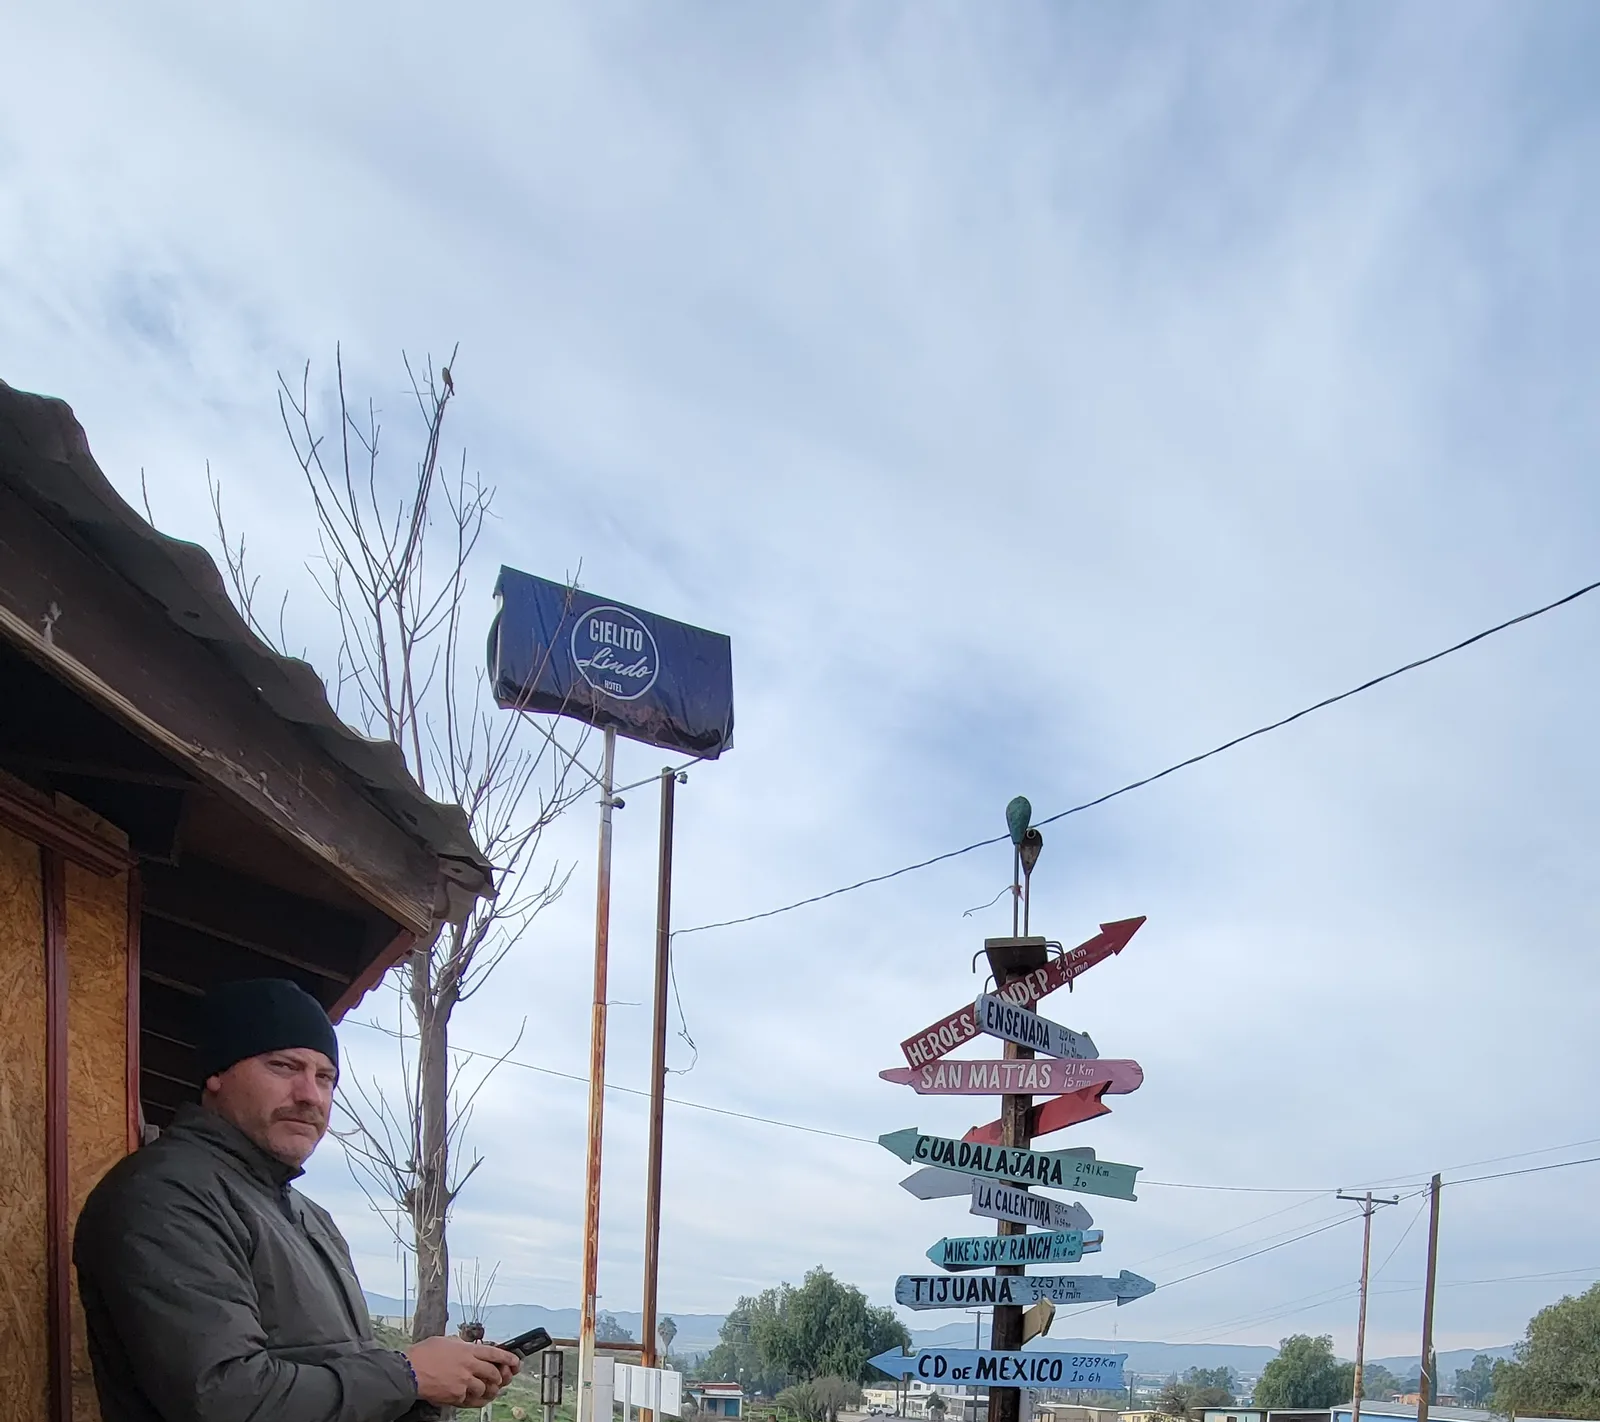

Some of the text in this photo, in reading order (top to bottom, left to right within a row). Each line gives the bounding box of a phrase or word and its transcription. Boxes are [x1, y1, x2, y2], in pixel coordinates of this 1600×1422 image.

[589, 618, 643, 652] CIELITO
[576, 647, 653, 678] Lindo
[604, 679, 623, 694] HOTEL
[1070, 948, 1087, 961] Km
[1060, 967, 1073, 981] 20
[987, 1001, 1050, 1050] ENSENADA
[906, 1013, 976, 1067] HEROES
[920, 1063, 1052, 1089] SAN MATIAS
[1065, 1063, 1095, 1076] 21 Km
[1063, 1077, 1074, 1088] 15
[913, 1135, 1063, 1185] GUADALAJARA
[978, 1185, 1051, 1226] LA CALENTURA
[943, 1236, 1053, 1262] MIKE'S SKY RANCH
[911, 1277, 1014, 1302] TIJUANA
[1030, 1276, 1075, 1288] 225 Km
[1052, 1289, 1064, 1300] 24
[918, 1354, 1063, 1382] CD DE MEXICO
[1072, 1356, 1116, 1369] 2739 Km
[1088, 1373, 1101, 1383] 6h
